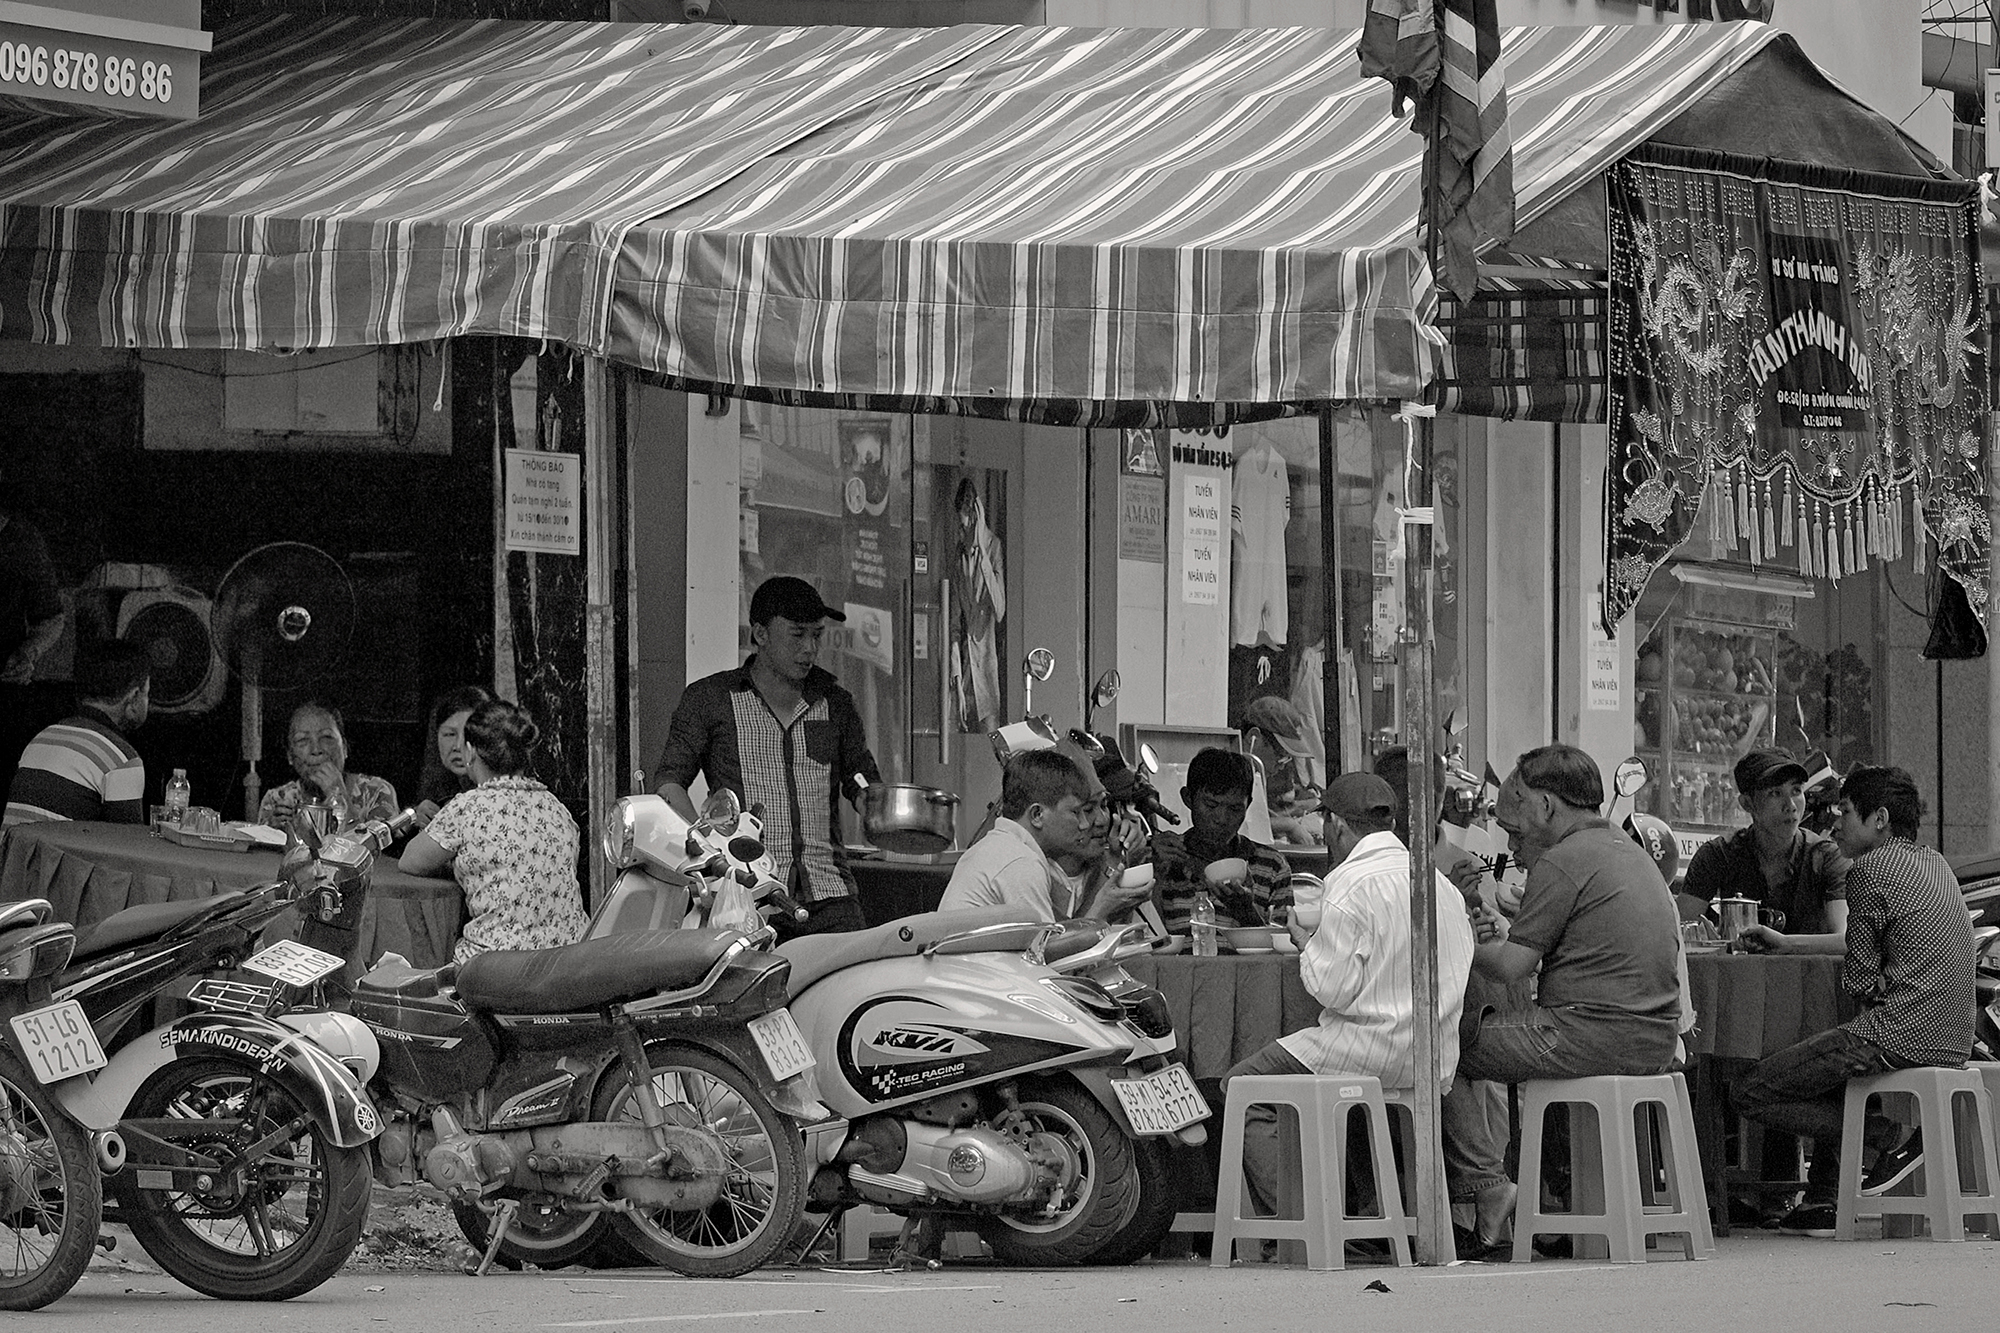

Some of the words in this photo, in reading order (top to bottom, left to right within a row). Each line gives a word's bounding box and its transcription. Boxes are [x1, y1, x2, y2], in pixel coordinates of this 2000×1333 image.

[0, 41, 48, 86] 096
[52, 49, 99, 92] 878
[103, 56, 137, 98] 86
[140, 61, 173, 103] 86
[522, 457, 547, 472] THÔNG
[1124, 505, 1160, 525] AMARI
[1647, 827, 1666, 860] Grab
[1681, 840, 1693, 856] XE
[278, 953, 337, 983] 912.08
[533, 1017, 570, 1025] HONDA
[376, 1028, 414, 1042] HONDA
[38, 1038, 95, 1076] 1212
[770, 1040, 807, 1073] 8343
[922, 1062, 966, 1079] RACING
[504, 1102, 550, 1117] Dream
[1165, 1093, 1204, 1124] 6772
[1130, 1108, 1170, 1131] 878.23
